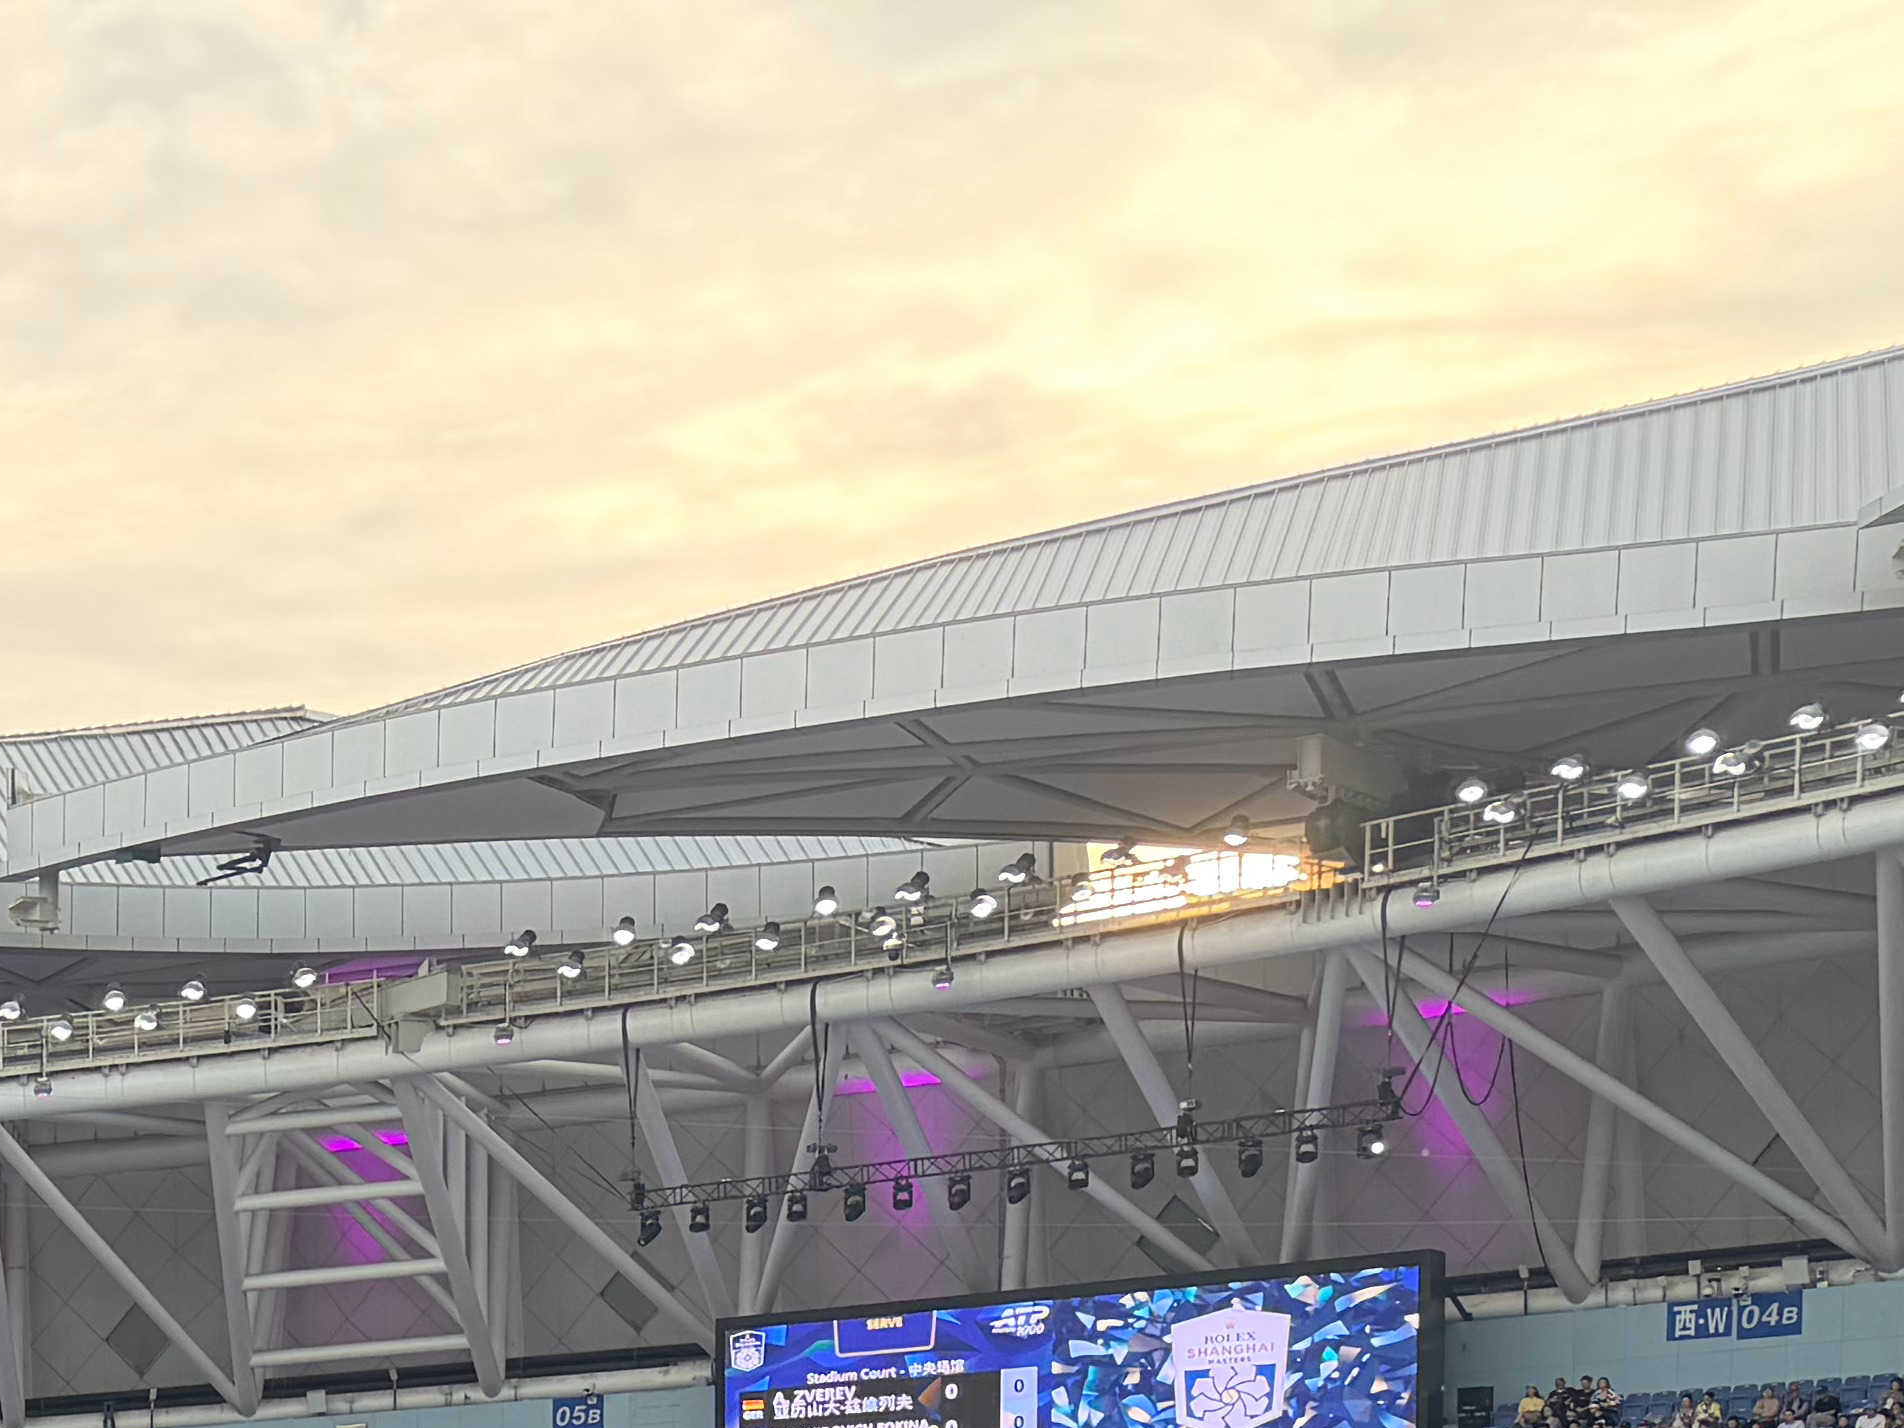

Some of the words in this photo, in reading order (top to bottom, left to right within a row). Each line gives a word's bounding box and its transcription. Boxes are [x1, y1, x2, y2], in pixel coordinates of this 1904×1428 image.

[866, 1316, 903, 1331] SERVE
[1741, 1302, 1798, 1329] 04B
[1203, 1331, 1256, 1345] ROLEX
[1186, 1342, 1275, 1360] SHANGHAI
[1208, 1356, 1252, 1365] MASTERS
[806, 1371, 857, 1385] Stadium
[862, 1368, 896, 1381] Court
[944, 1384, 958, 1400] 0
[1013, 1379, 1024, 1393] 0
[793, 1386, 856, 1403] ZVEREV
[556, 1406, 600, 1426] 05B
